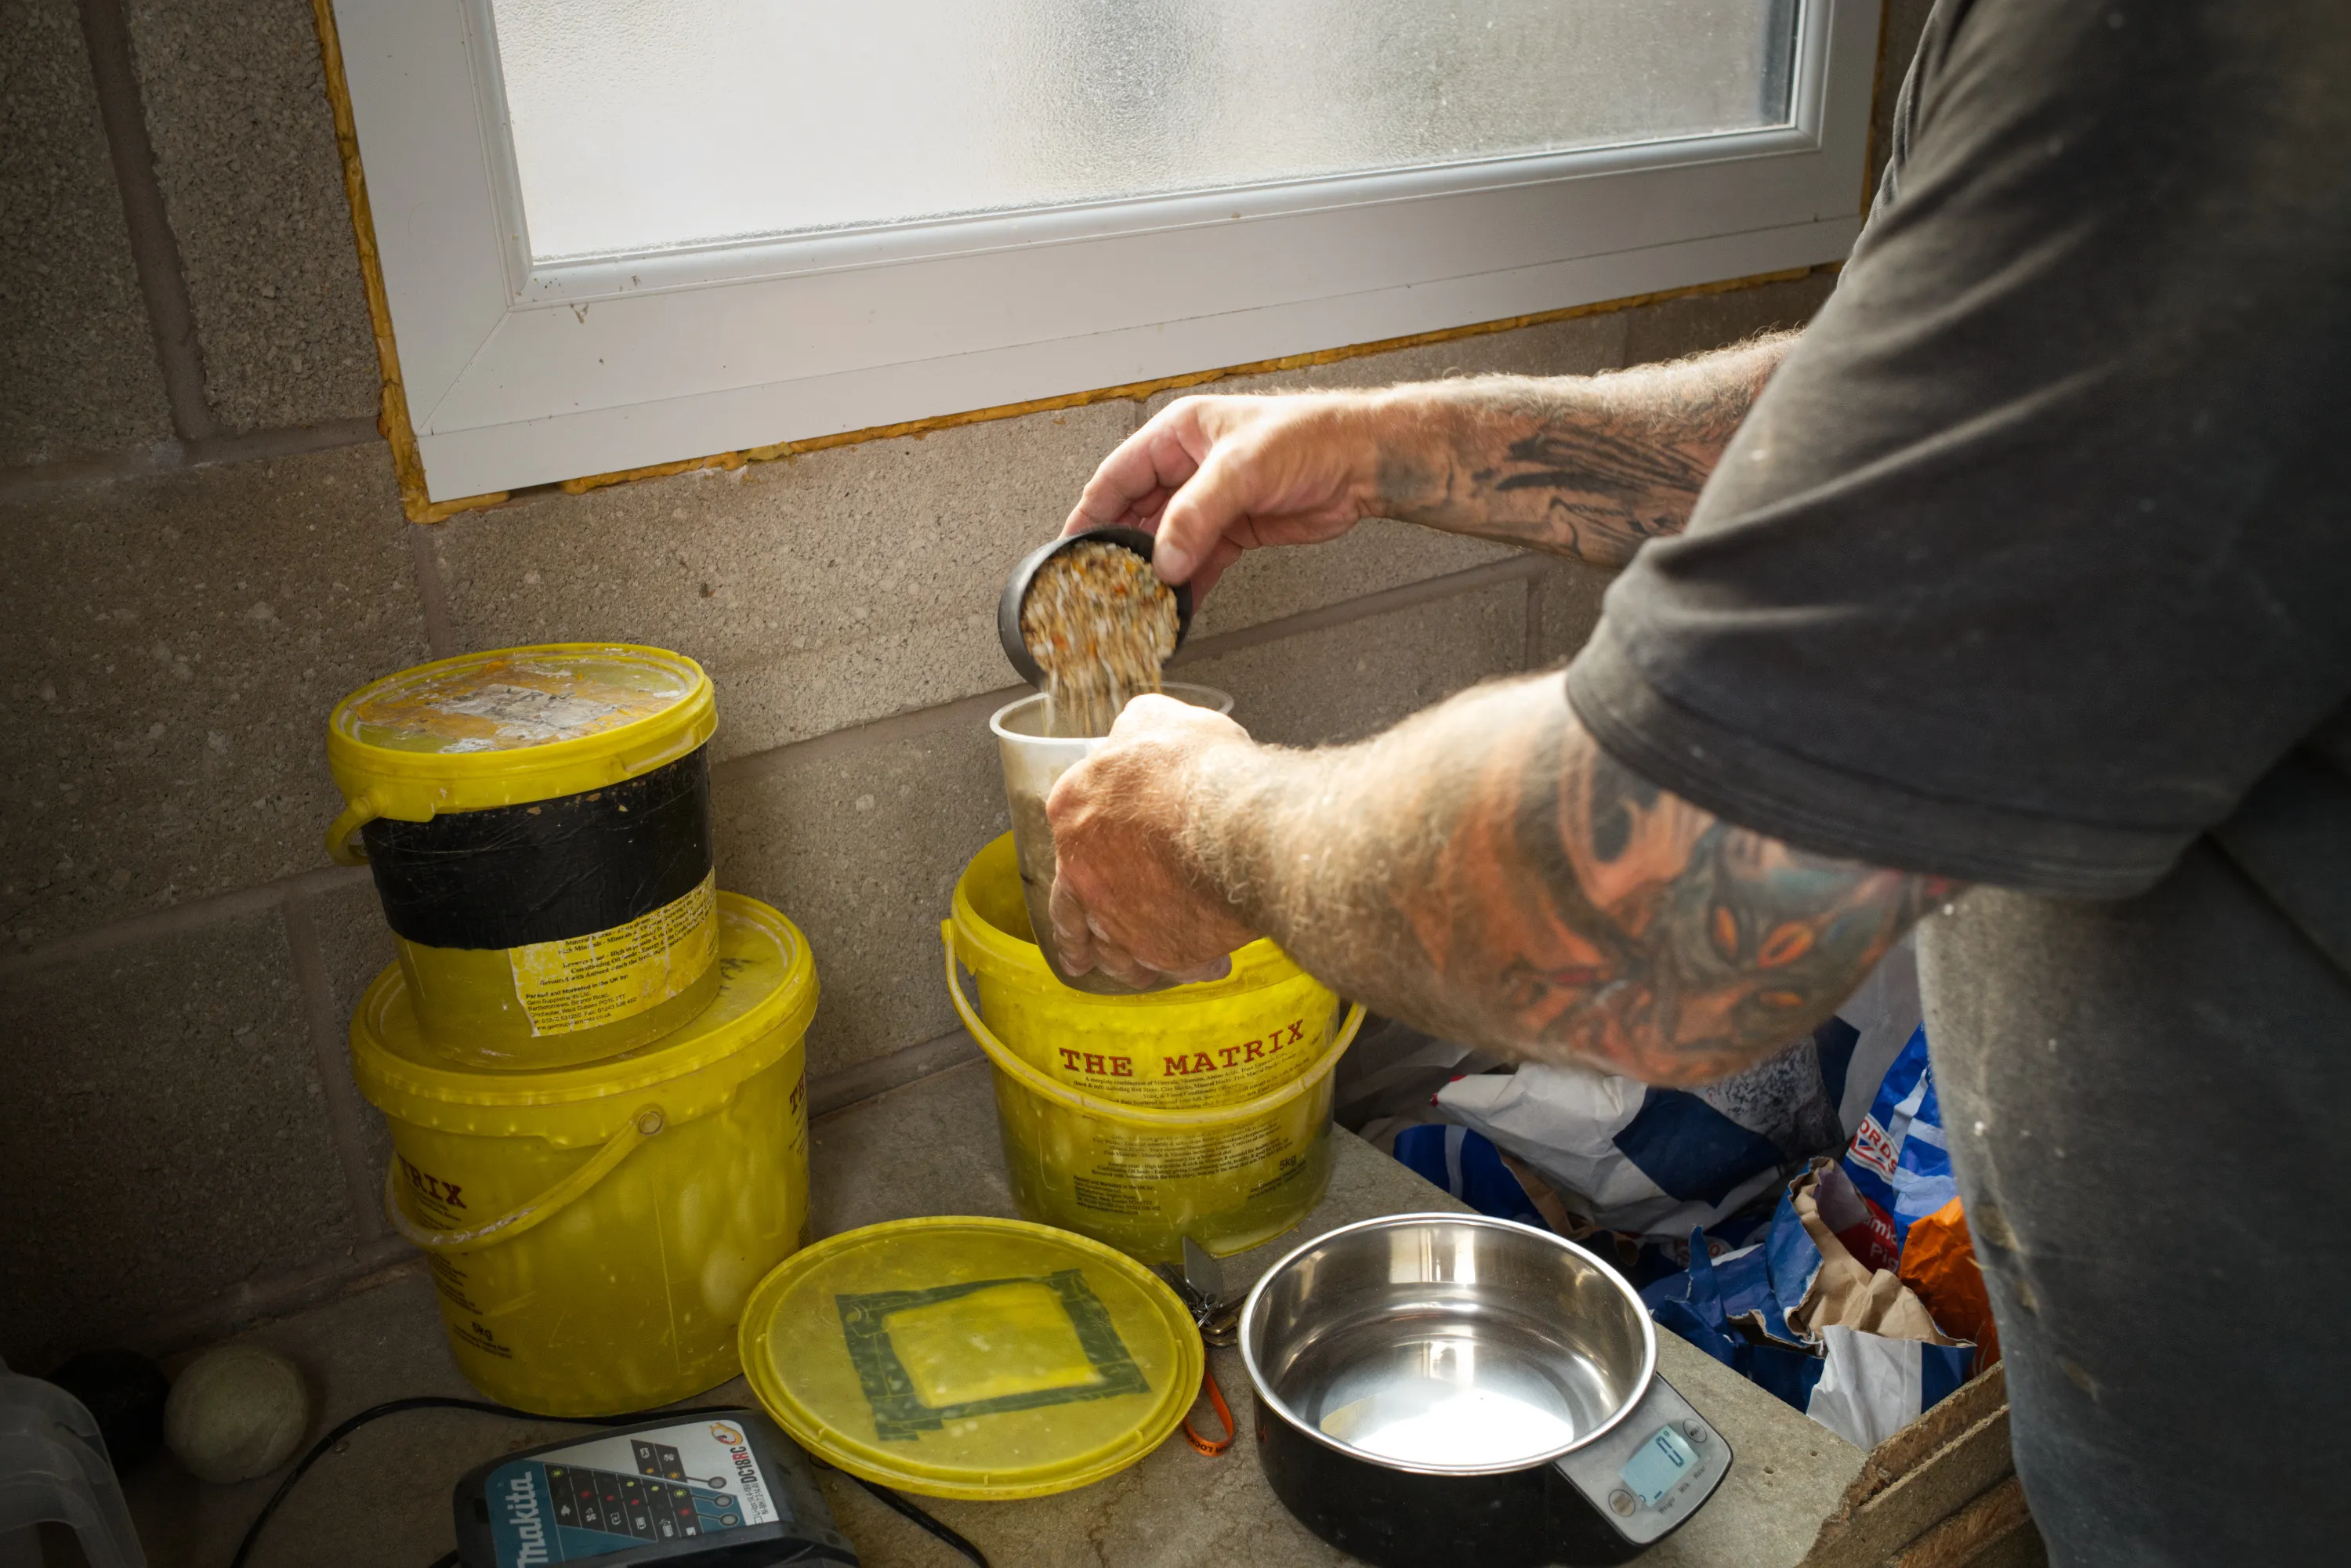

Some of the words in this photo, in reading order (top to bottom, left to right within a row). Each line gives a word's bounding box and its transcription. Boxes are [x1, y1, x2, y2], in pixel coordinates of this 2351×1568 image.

[610, 947, 625, 958] High
[611, 955, 621, 964] Oil
[585, 967, 610, 979] Aniseed
[562, 983, 592, 995] Marketed
[600, 979, 610, 987] the
[542, 992, 580, 1005] Supplements
[577, 1001, 598, 1011] Sussex
[597, 1004, 615, 1013] 01243
[1059, 1047, 1132, 1077] THE
[1164, 1019, 1303, 1077] MATRIX
[1207, 1072, 1223, 1081] Amino
[1246, 1067, 1264, 1078] Mineral
[1183, 1086, 1217, 1097] Conditioning
[1279, 1154, 1297, 1171] 5kg
[472, 1321, 494, 1342] 5kg
[1655, 1436, 1685, 1468] 0
[730, 1446, 758, 1484] DC18RC
[1679, 1481, 1691, 1494] Milk
[1693, 1465, 1707, 1479] Water
[505, 1471, 549, 1568] makita
